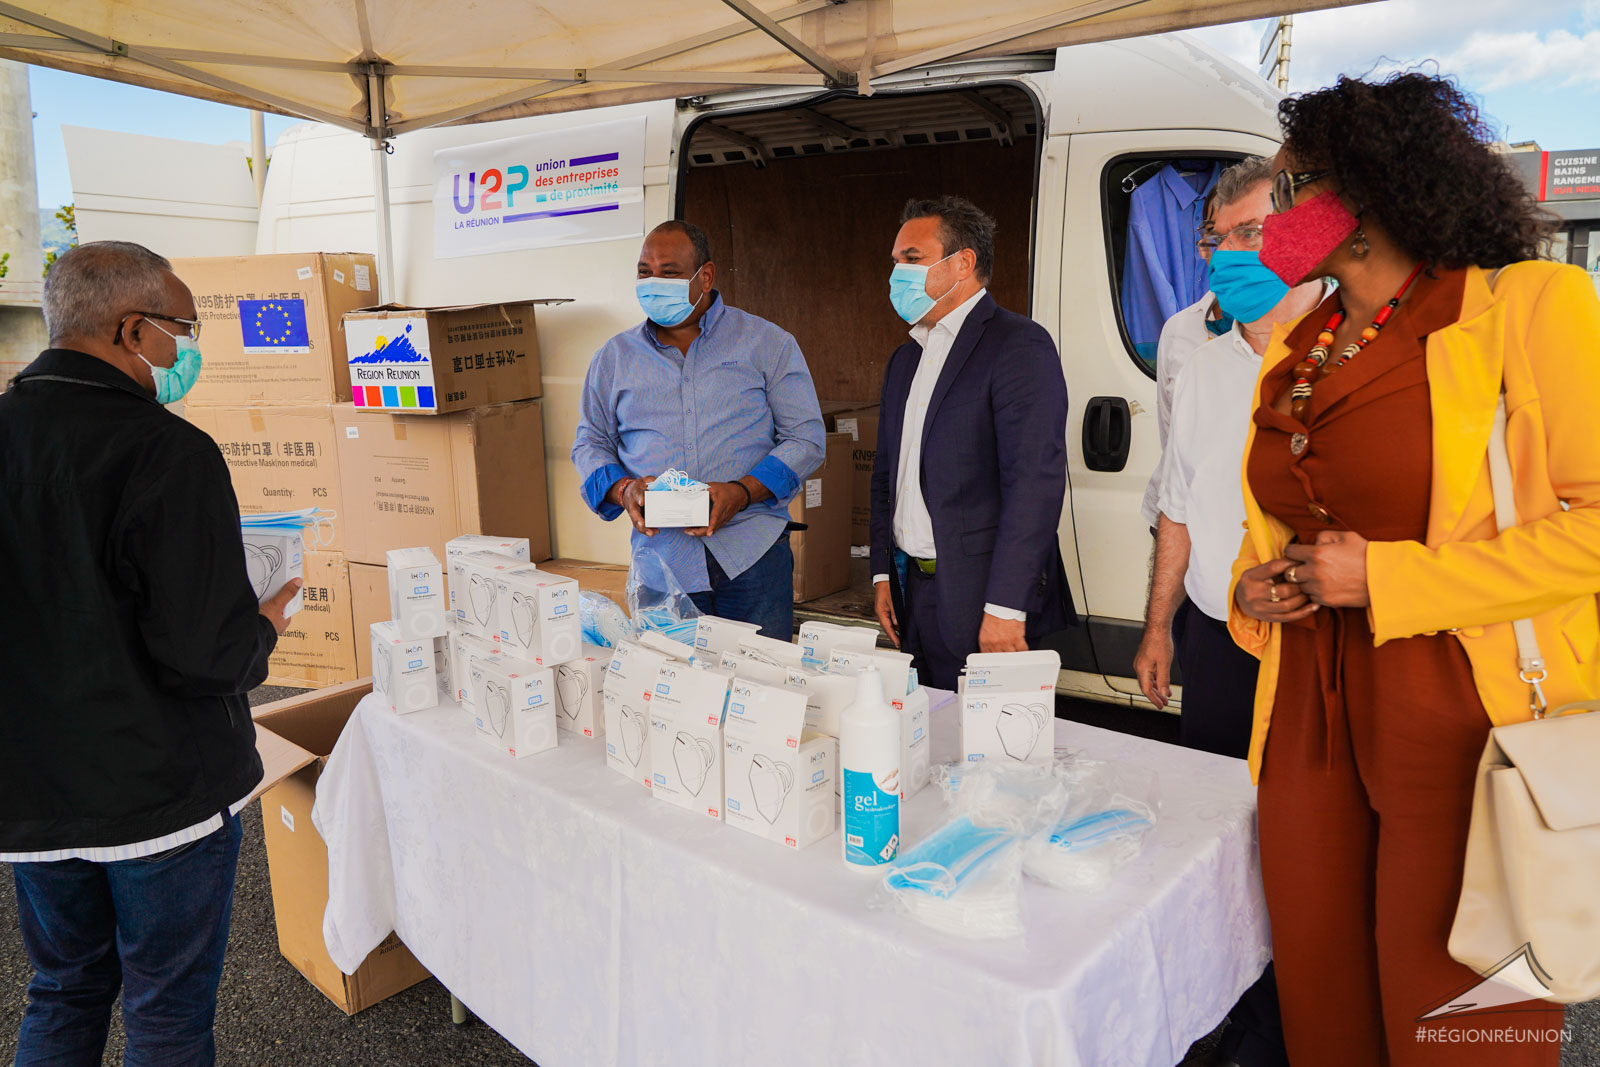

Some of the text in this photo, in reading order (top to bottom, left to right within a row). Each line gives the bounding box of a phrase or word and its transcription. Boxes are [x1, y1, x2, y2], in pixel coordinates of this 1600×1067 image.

[536, 158, 566, 172] union
[1554, 156, 1598, 166] CUISINE
[535, 166, 619, 188] des entreprises
[1554, 166, 1586, 176] BAINS
[453, 164, 530, 215] U2P
[550, 181, 619, 202] de proximité
[454, 216, 500, 230] LA RÉUNION
[452, 349, 526, 374] 一次性平面口罩
[357, 367, 420, 381] REGION REUNION
[227, 458, 258, 468] Protective
[262, 487, 328, 499] Quantity: PCS
[324, 631, 340, 642] PCS
[854, 790, 878, 812] gel
